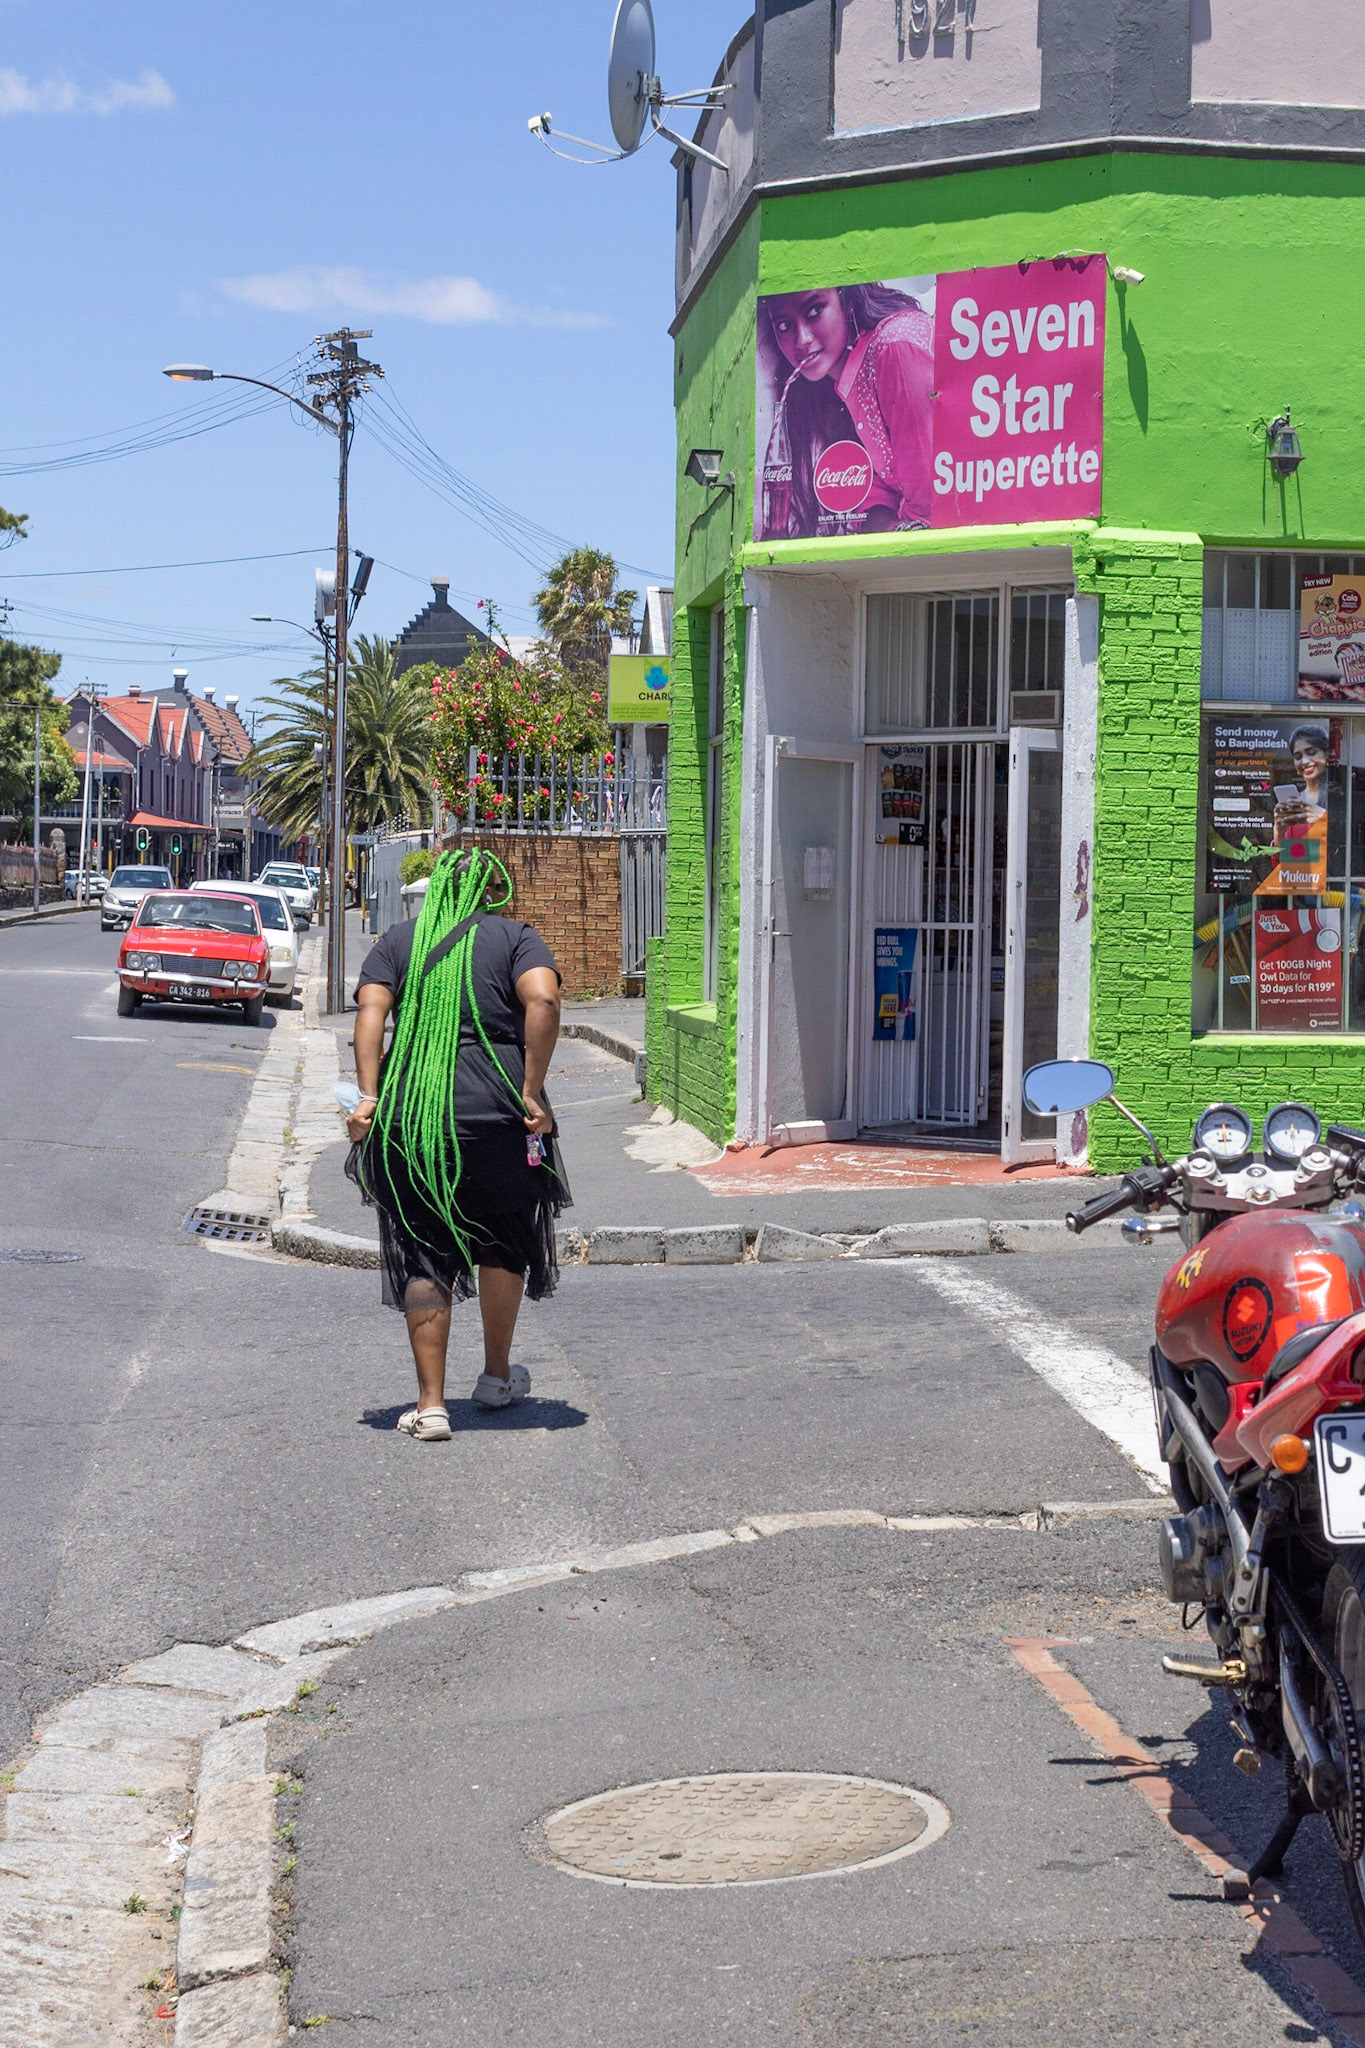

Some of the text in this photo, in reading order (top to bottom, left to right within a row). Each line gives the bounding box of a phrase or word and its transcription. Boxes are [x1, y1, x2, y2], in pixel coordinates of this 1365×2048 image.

[949, 296, 1095, 361] Seven
[970, 373, 1073, 438] Star
[933, 440, 1099, 502] Superette
[816, 464, 867, 490] Coca-Cola
[1304, 577, 1331, 587] TRY NEW
[1308, 641, 1331, 651] limited
[1309, 649, 1332, 657] edition
[638, 692, 670, 701] CHAR
[1215, 727, 1278, 739] Send money
[1215, 738, 1287, 749] to Bangladesh
[1278, 870, 1320, 883] Mukuru
[877, 936, 899, 945] RED BULL
[876, 946, 903, 956] GIVES YOU
[1260, 960, 1331, 970] Get 100GB Night
[1260, 972, 1312, 981] Owl Data for
[169, 986, 210, 997] CA 342-816
[1260, 984, 1271, 993] 30
[1273, 984, 1293, 995] days
[1295, 983, 1307, 992] for
[883, 1003, 896, 1013] HERE
[1230, 1322, 1262, 1338] SUZUKI
